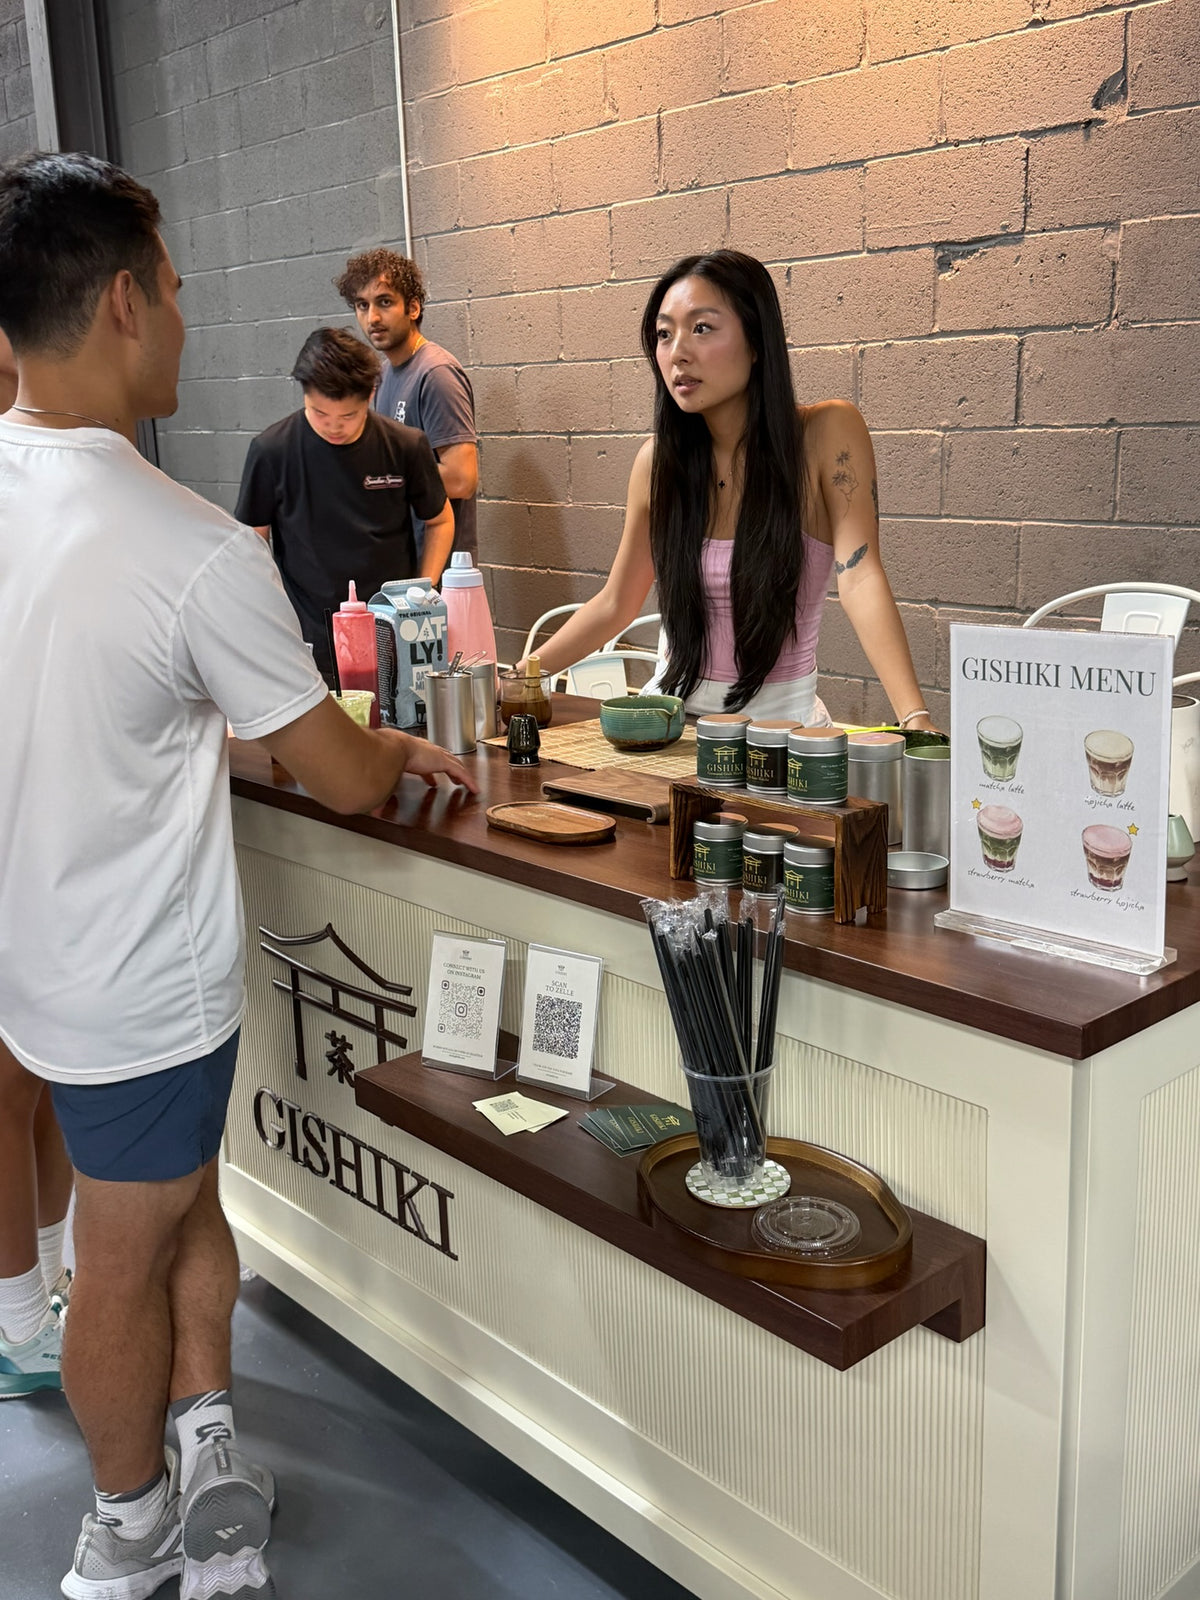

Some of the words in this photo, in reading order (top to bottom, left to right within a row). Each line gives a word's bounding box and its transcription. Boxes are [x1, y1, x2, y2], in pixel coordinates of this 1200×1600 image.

[409, 639, 443, 665] LY!
[962, 656, 1062, 688] GISHIKI
[1070, 666, 1157, 696] MENU
[706, 763, 743, 772] GISHIKI
[979, 782, 1005, 792] matcha
[1008, 783, 1025, 794] latte
[1116, 799, 1136, 811] latte
[968, 867, 1005, 883] strawberry
[1008, 877, 1035, 888] matcha
[1070, 888, 1113, 905] strawberry
[1115, 896, 1145, 911] hojicha
[443, 962, 465, 971] CONNECT
[465, 965, 479, 973] WITH
[455, 970, 481, 980] INSTAGRAM
[551, 980, 568, 989] SCAN
[555, 988, 575, 997] ZELLE
[253, 1086, 458, 1261] GISHIKI
